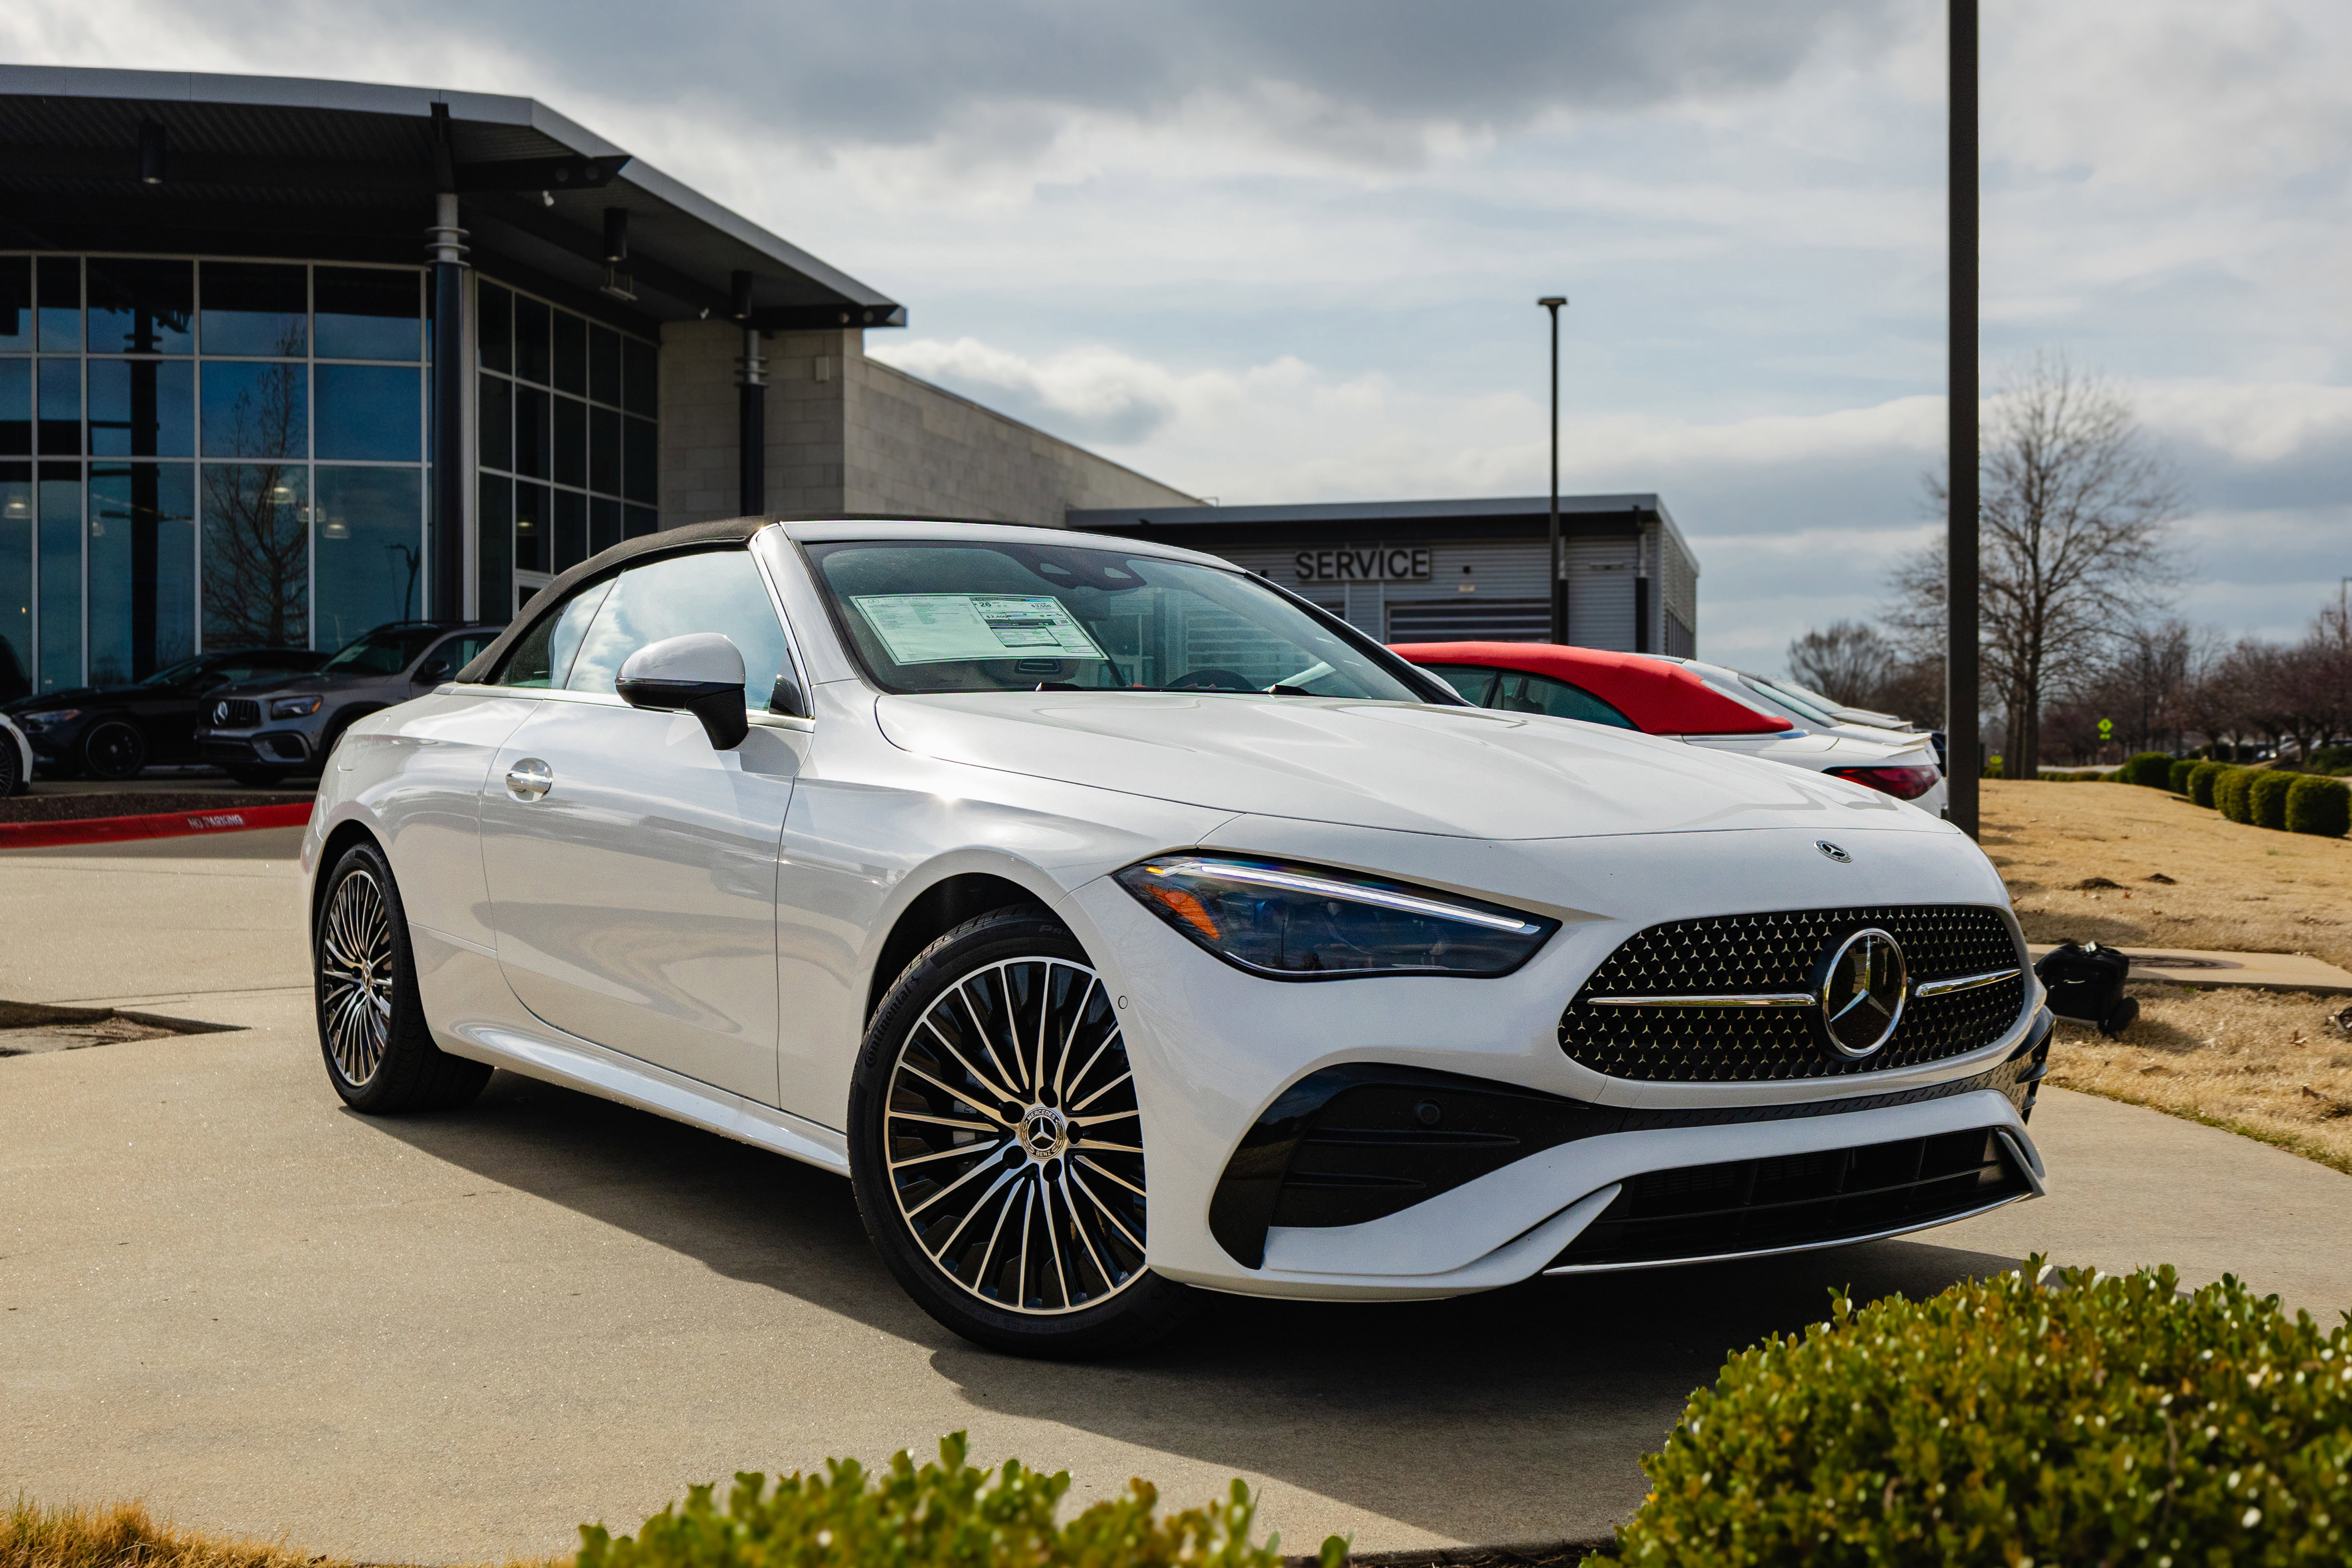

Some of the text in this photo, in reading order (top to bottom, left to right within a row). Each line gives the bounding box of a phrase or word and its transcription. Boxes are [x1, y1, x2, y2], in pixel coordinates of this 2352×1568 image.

[1295, 549, 1428, 579] SERVICE
[187, 814, 243, 829] NO PARKING
[864, 984, 913, 1068] Continental
[1027, 1110, 1056, 1121] MERCEDES
